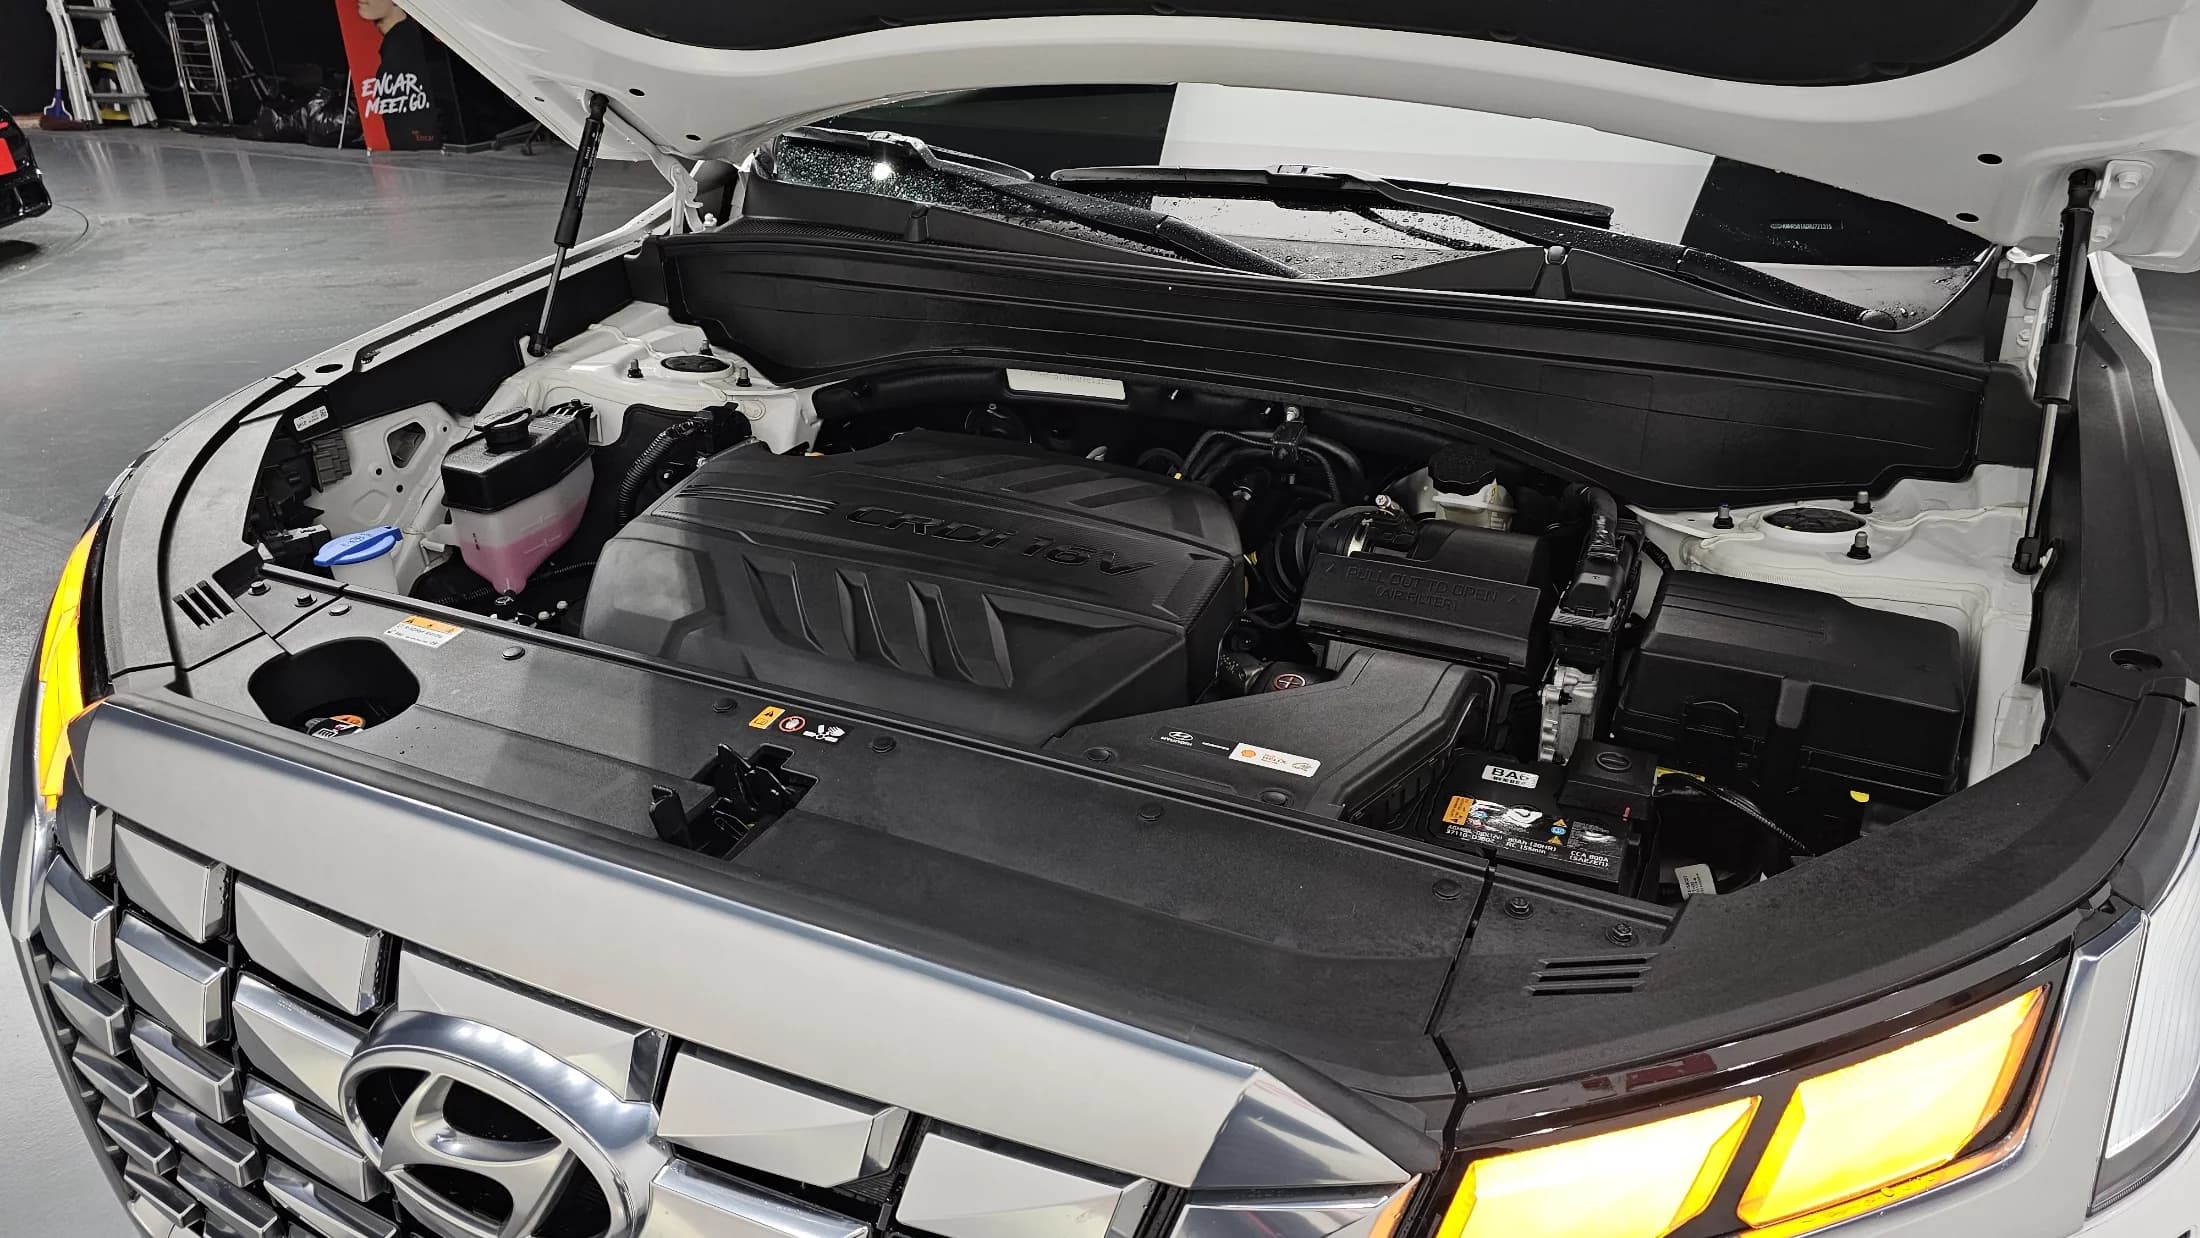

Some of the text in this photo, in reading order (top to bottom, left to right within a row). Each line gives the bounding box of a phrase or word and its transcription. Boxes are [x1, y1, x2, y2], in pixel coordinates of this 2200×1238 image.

[361, 72, 423, 98] ENCAR.
[845, 505, 1158, 577] CRDi 16V
[1345, 565, 1499, 603] PULL OUT TO OPEN
